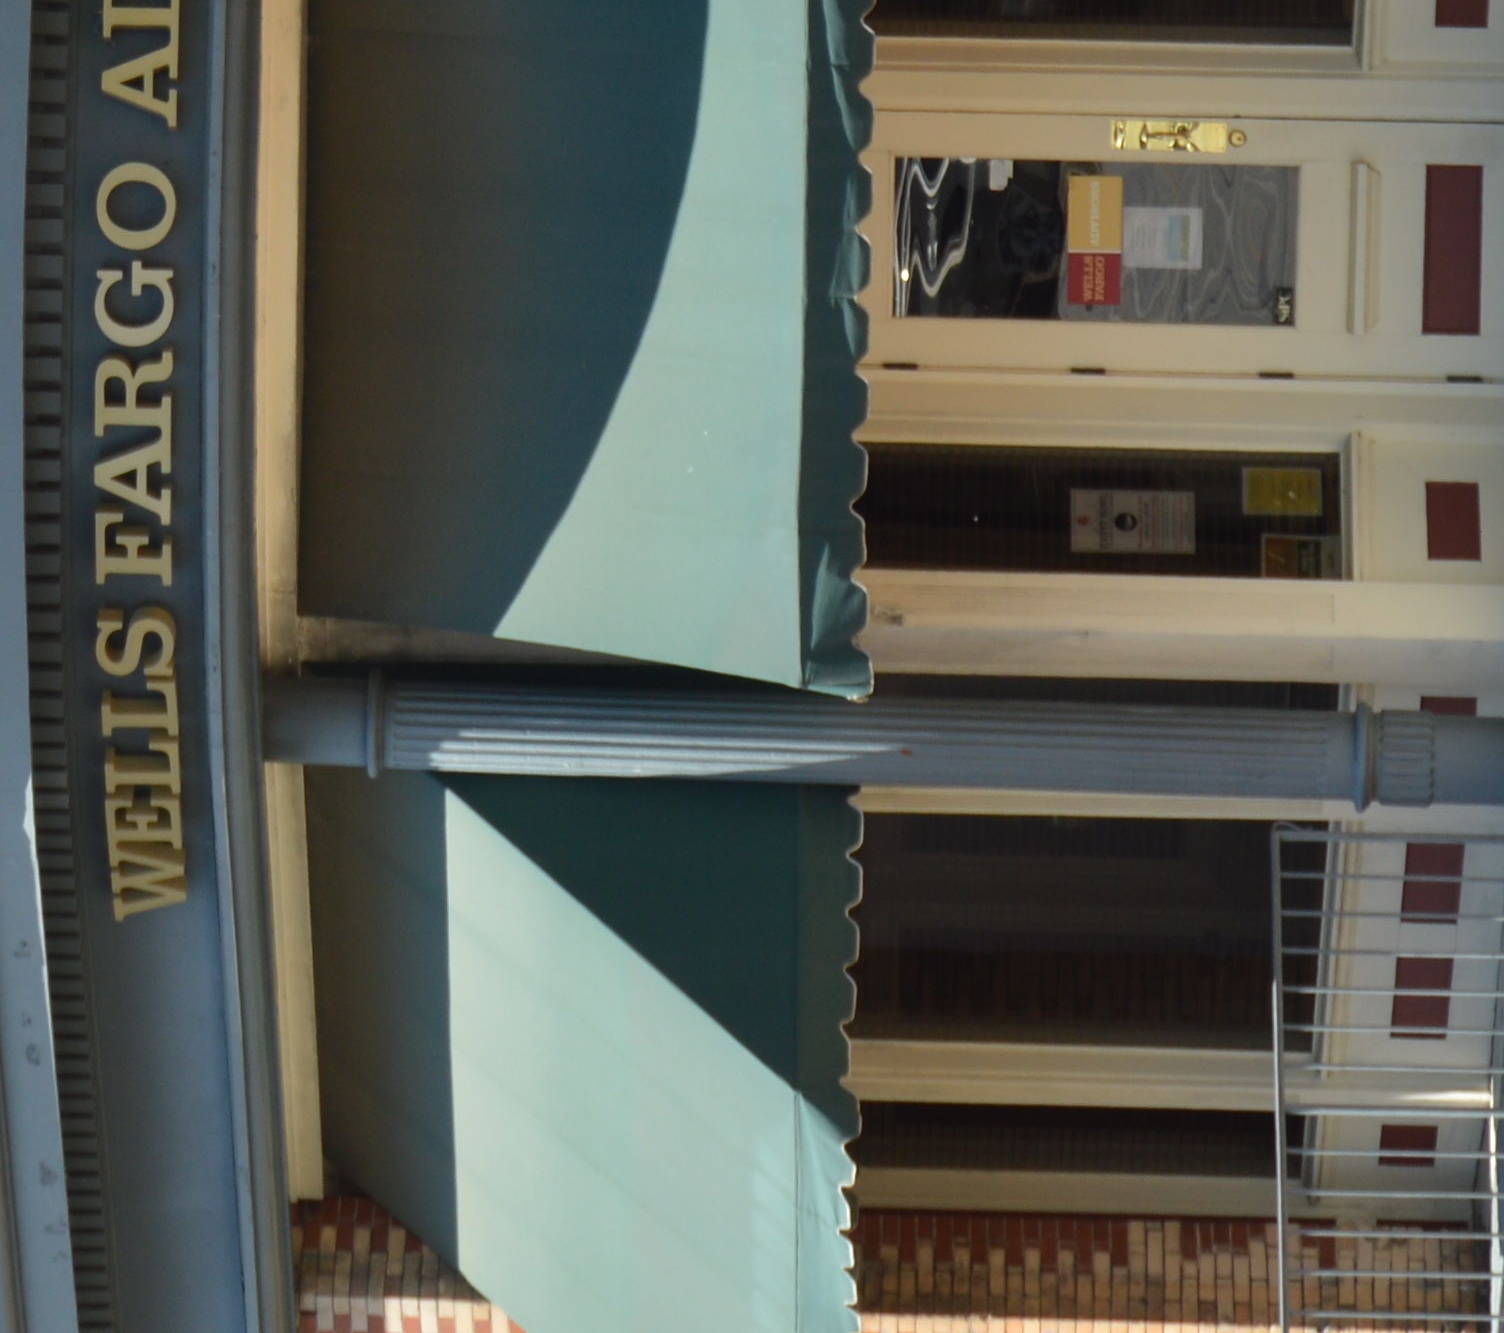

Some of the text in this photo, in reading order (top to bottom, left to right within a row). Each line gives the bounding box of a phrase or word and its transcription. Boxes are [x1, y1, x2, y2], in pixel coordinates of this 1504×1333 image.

[1090, 181, 1100, 246] ADVISORS
[1083, 256, 1093, 301] WELLS
[1095, 256, 1105, 301] FARGO
[94, 163, 177, 586] FARGO
[96, 608, 188, 921] WELLS
